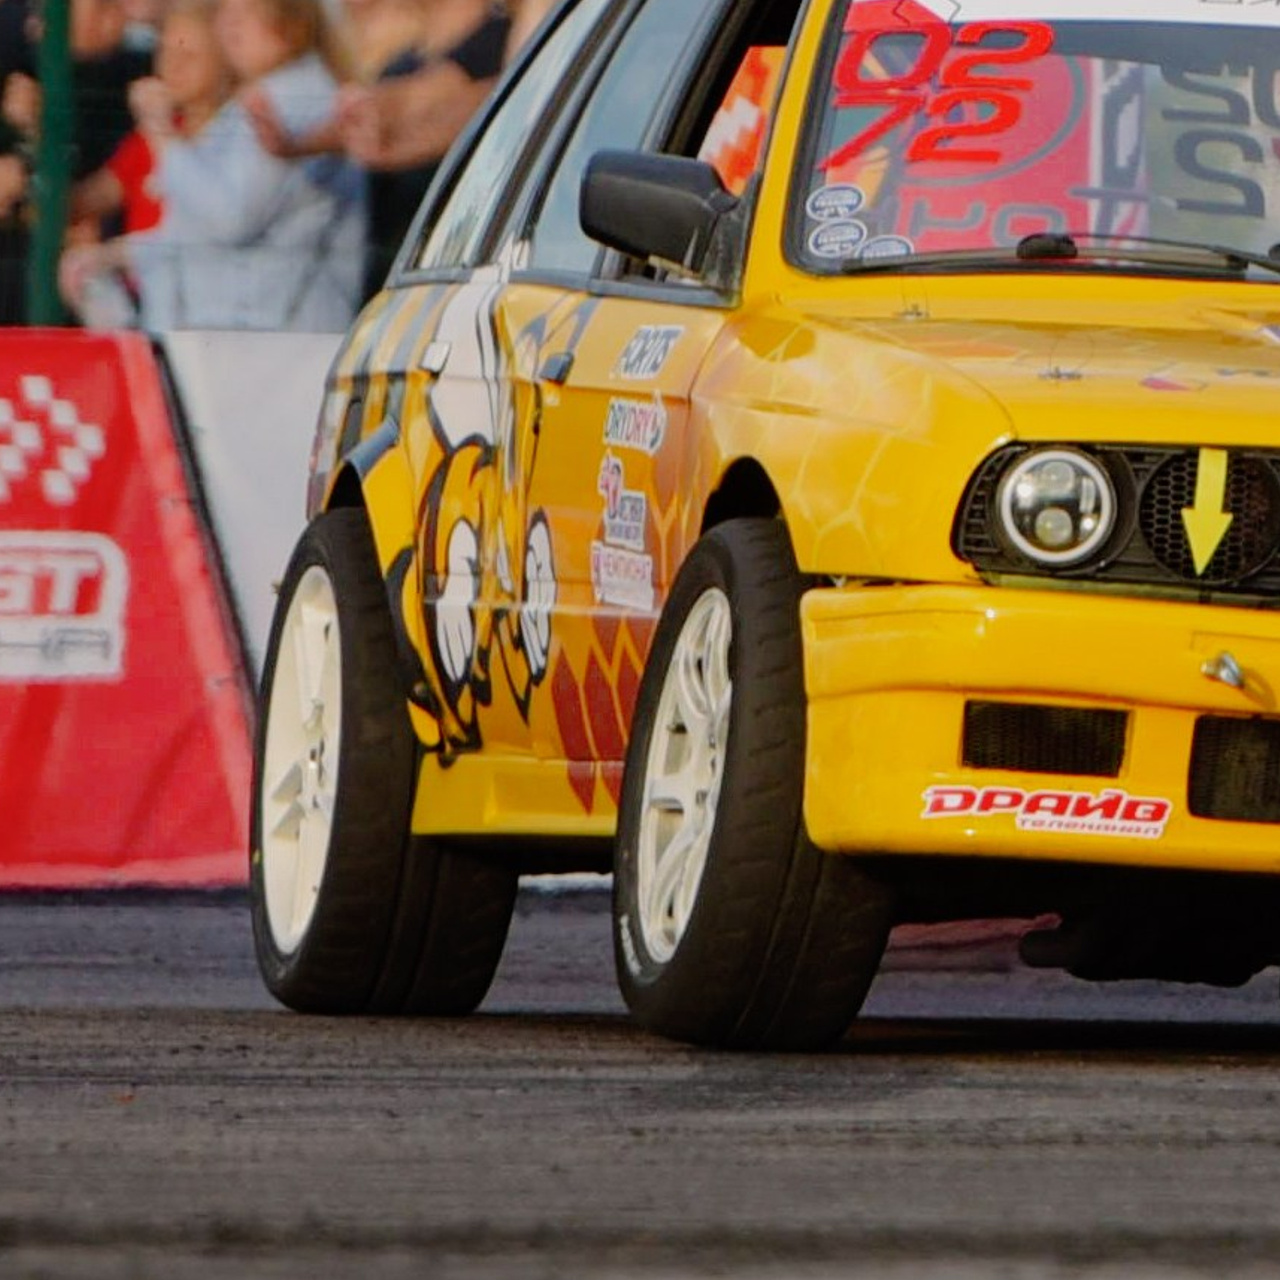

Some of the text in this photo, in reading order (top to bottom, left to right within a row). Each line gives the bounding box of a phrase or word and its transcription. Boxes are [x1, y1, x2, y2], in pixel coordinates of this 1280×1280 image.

[834, 19, 1056, 92] 02
[818, 89, 1022, 172] 72
[927, 788, 1170, 822] ДРАЙВ
